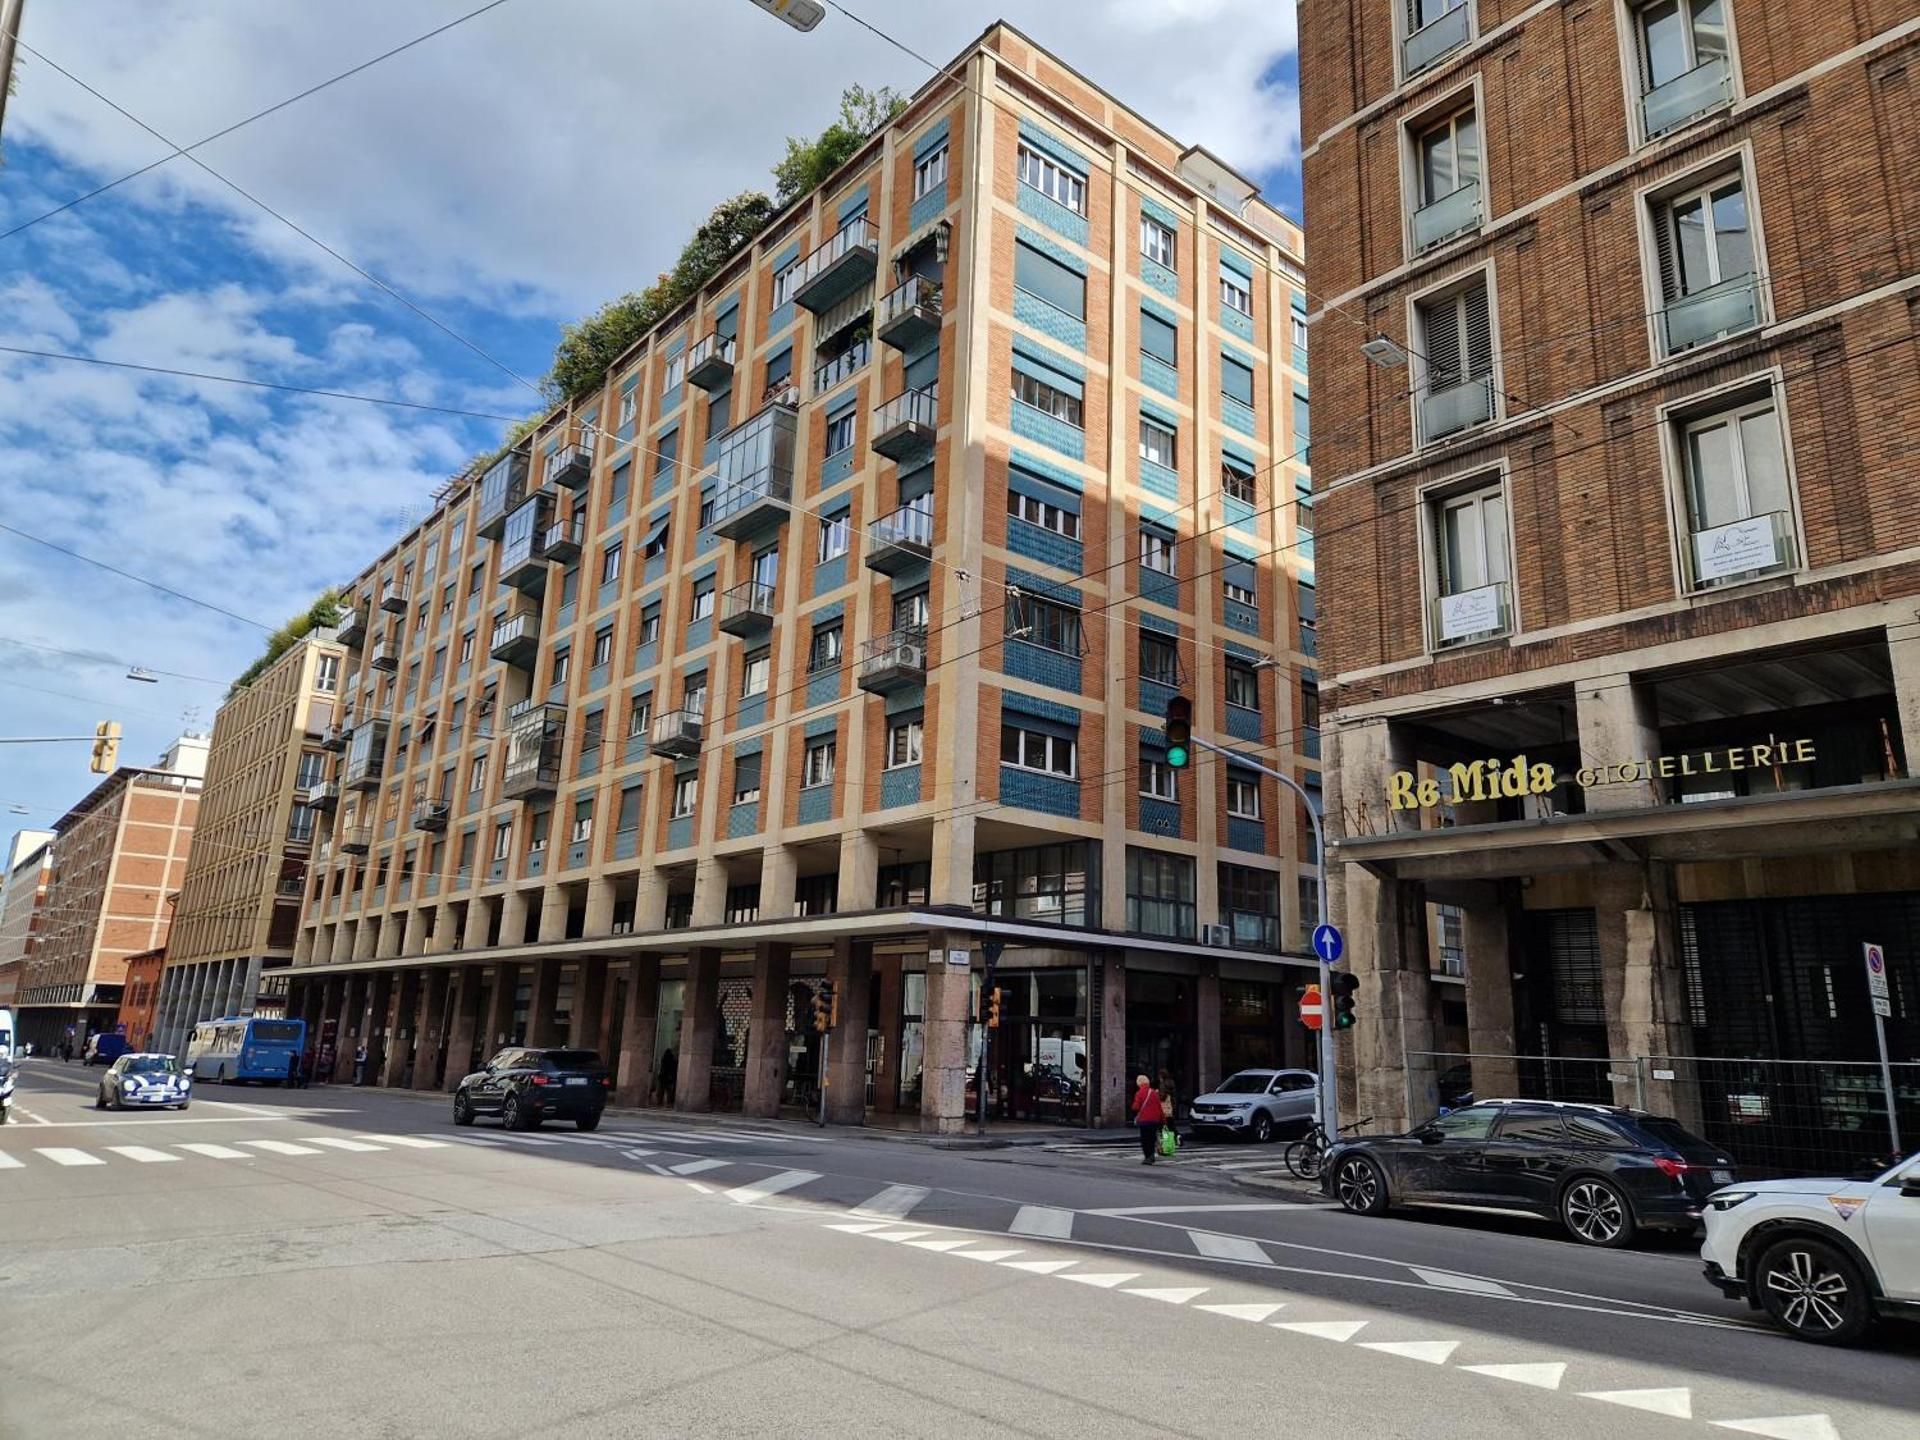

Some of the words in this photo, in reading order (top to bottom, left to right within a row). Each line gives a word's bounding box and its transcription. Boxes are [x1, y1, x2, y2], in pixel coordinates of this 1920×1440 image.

[1389, 771, 1441, 810] Re
[1449, 754, 1557, 804] Mida
[1576, 739, 1816, 787] GIOIELLERIE
